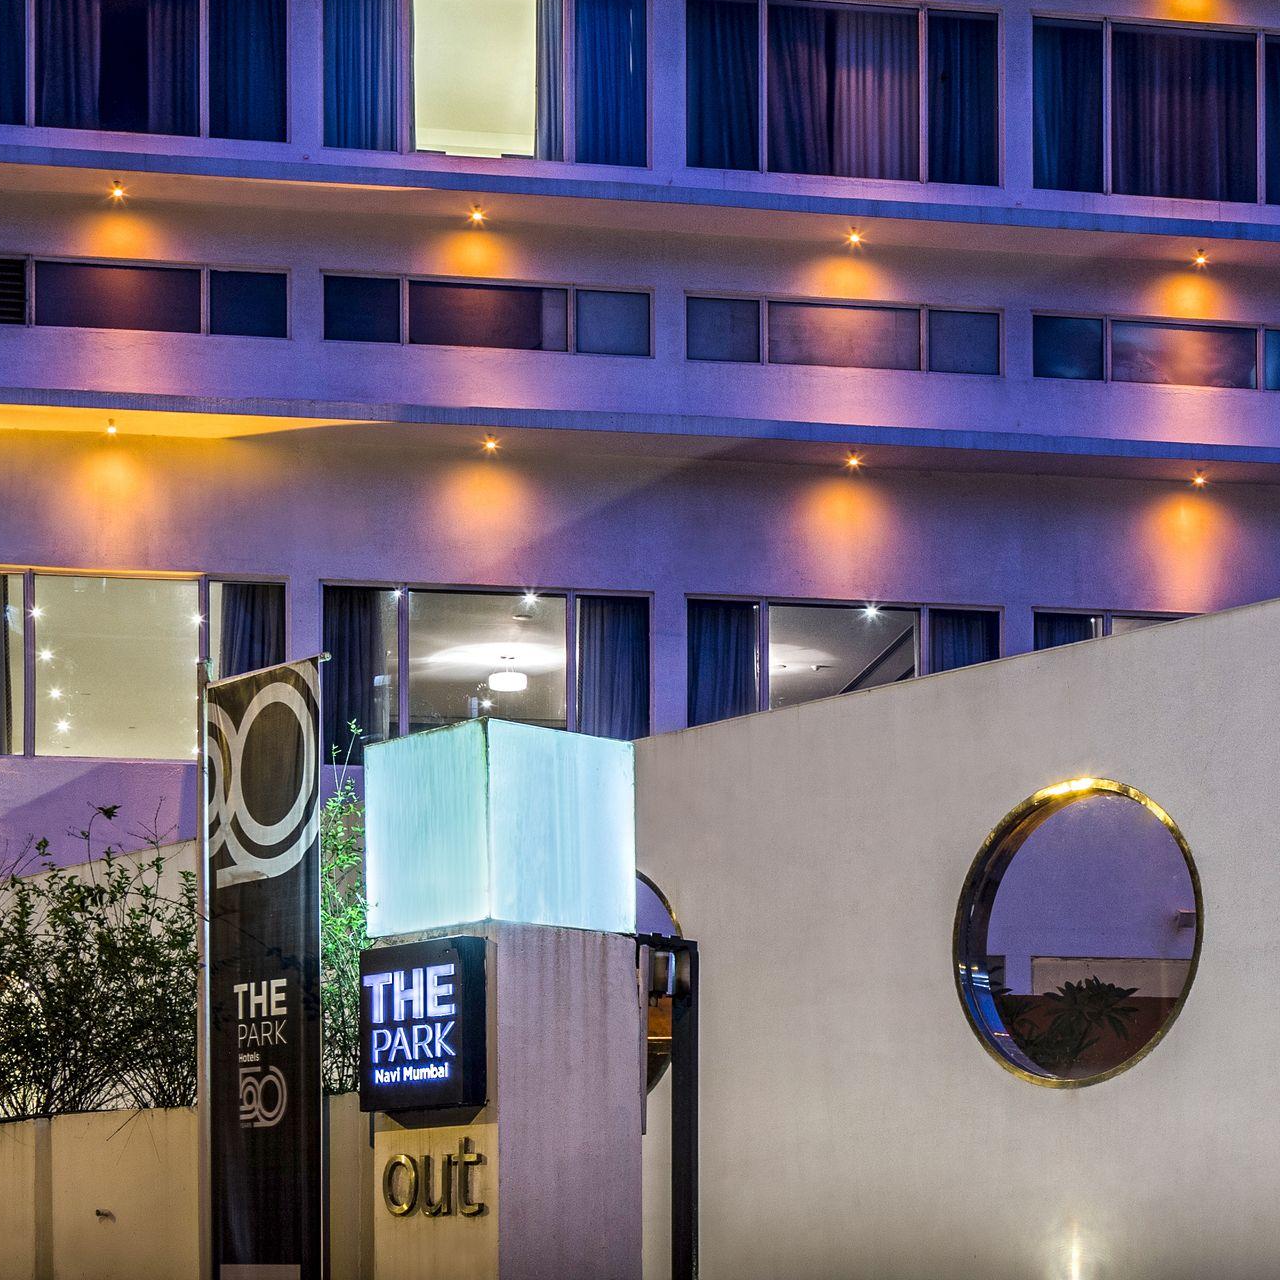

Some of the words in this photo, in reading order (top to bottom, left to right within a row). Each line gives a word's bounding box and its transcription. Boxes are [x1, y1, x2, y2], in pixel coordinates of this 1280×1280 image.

[233, 978, 287, 1020] THE
[362, 963, 455, 1024] THE
[238, 1019, 288, 1049] PARK
[372, 1021, 456, 1064] PARK
[238, 1052, 260, 1063] Hotels
[374, 1068, 401, 1084] Navi
[402, 1062, 449, 1081] Mumbai
[382, 1136, 487, 1217] out
